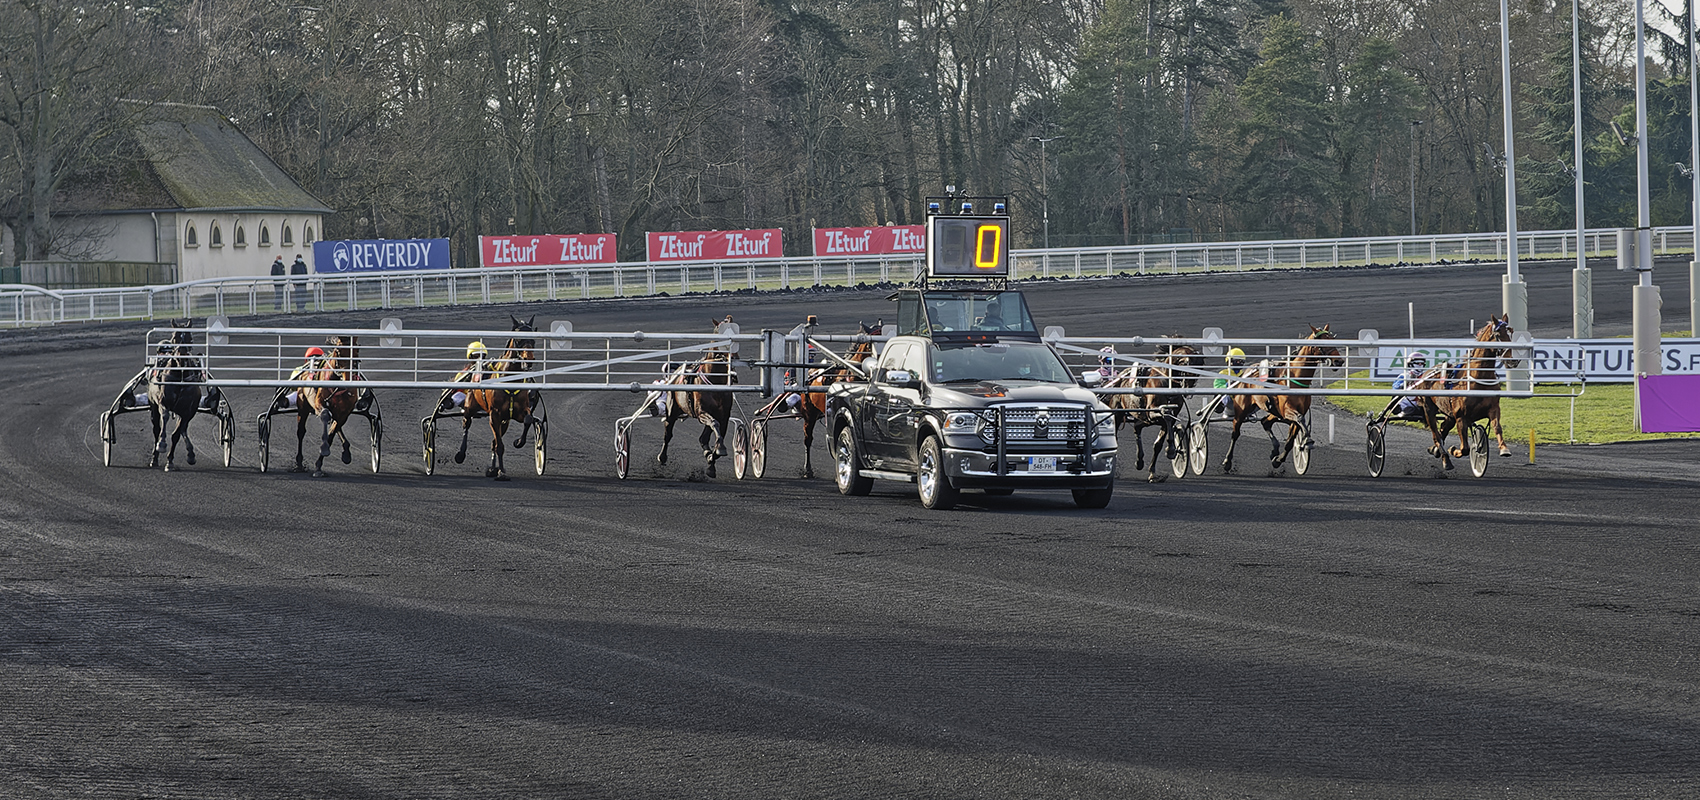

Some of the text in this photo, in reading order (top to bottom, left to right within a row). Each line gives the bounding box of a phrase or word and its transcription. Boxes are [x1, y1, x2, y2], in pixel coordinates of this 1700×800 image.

[493, 237, 606, 263] ZEturf ZEturf
[659, 232, 772, 258] ZEturf ZEturf
[825, 228, 925, 253] ZEturf ZEtu
[975, 225, 1001, 268] 0
[352, 242, 431, 268] REVERDY
